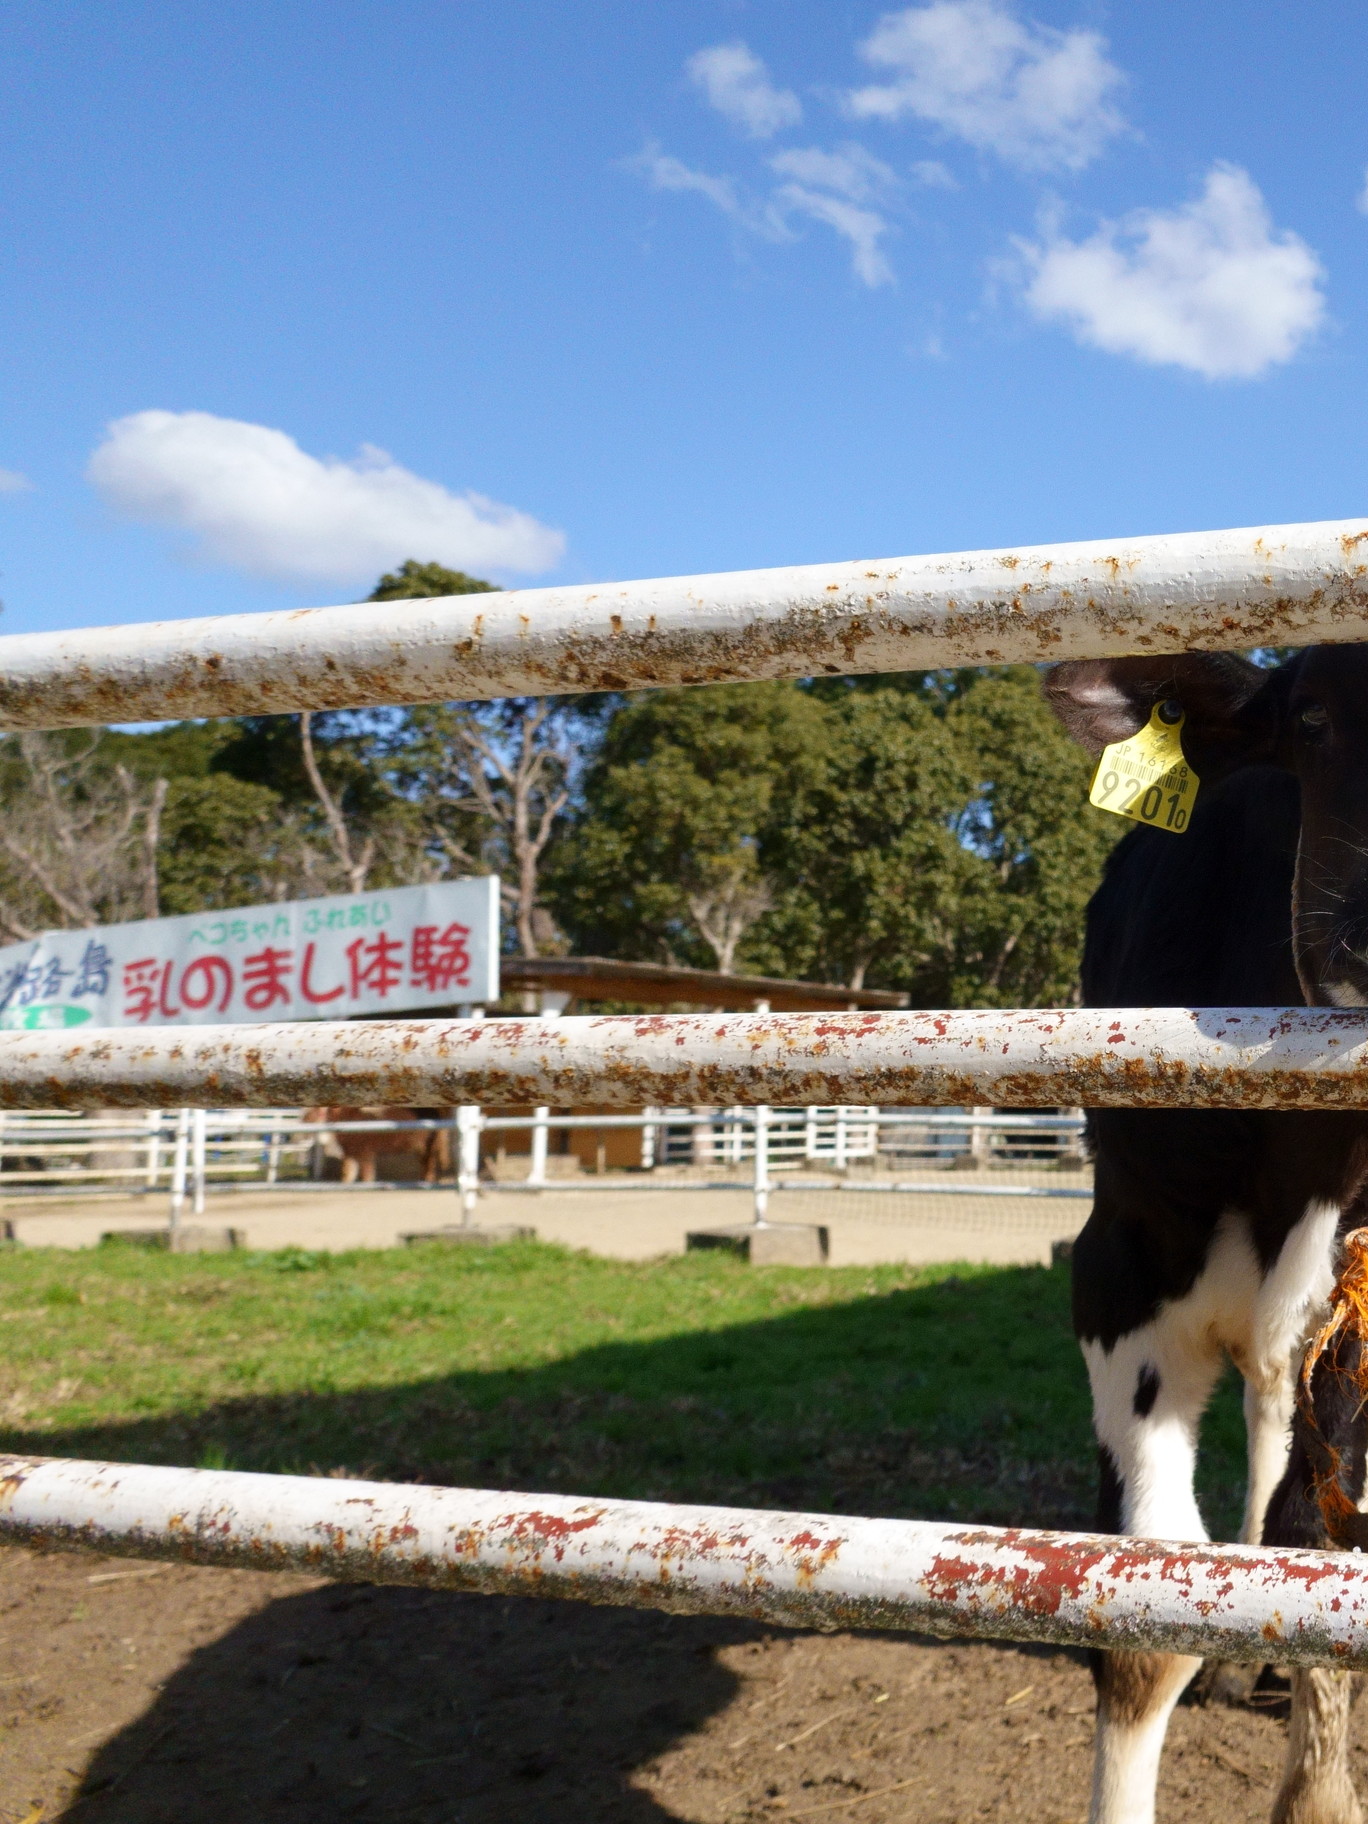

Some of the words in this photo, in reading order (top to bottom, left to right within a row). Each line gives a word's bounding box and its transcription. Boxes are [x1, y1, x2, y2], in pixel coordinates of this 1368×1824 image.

[1116, 743, 1131, 756] JP
[122, 922, 472, 1024] 乳のまし体験
